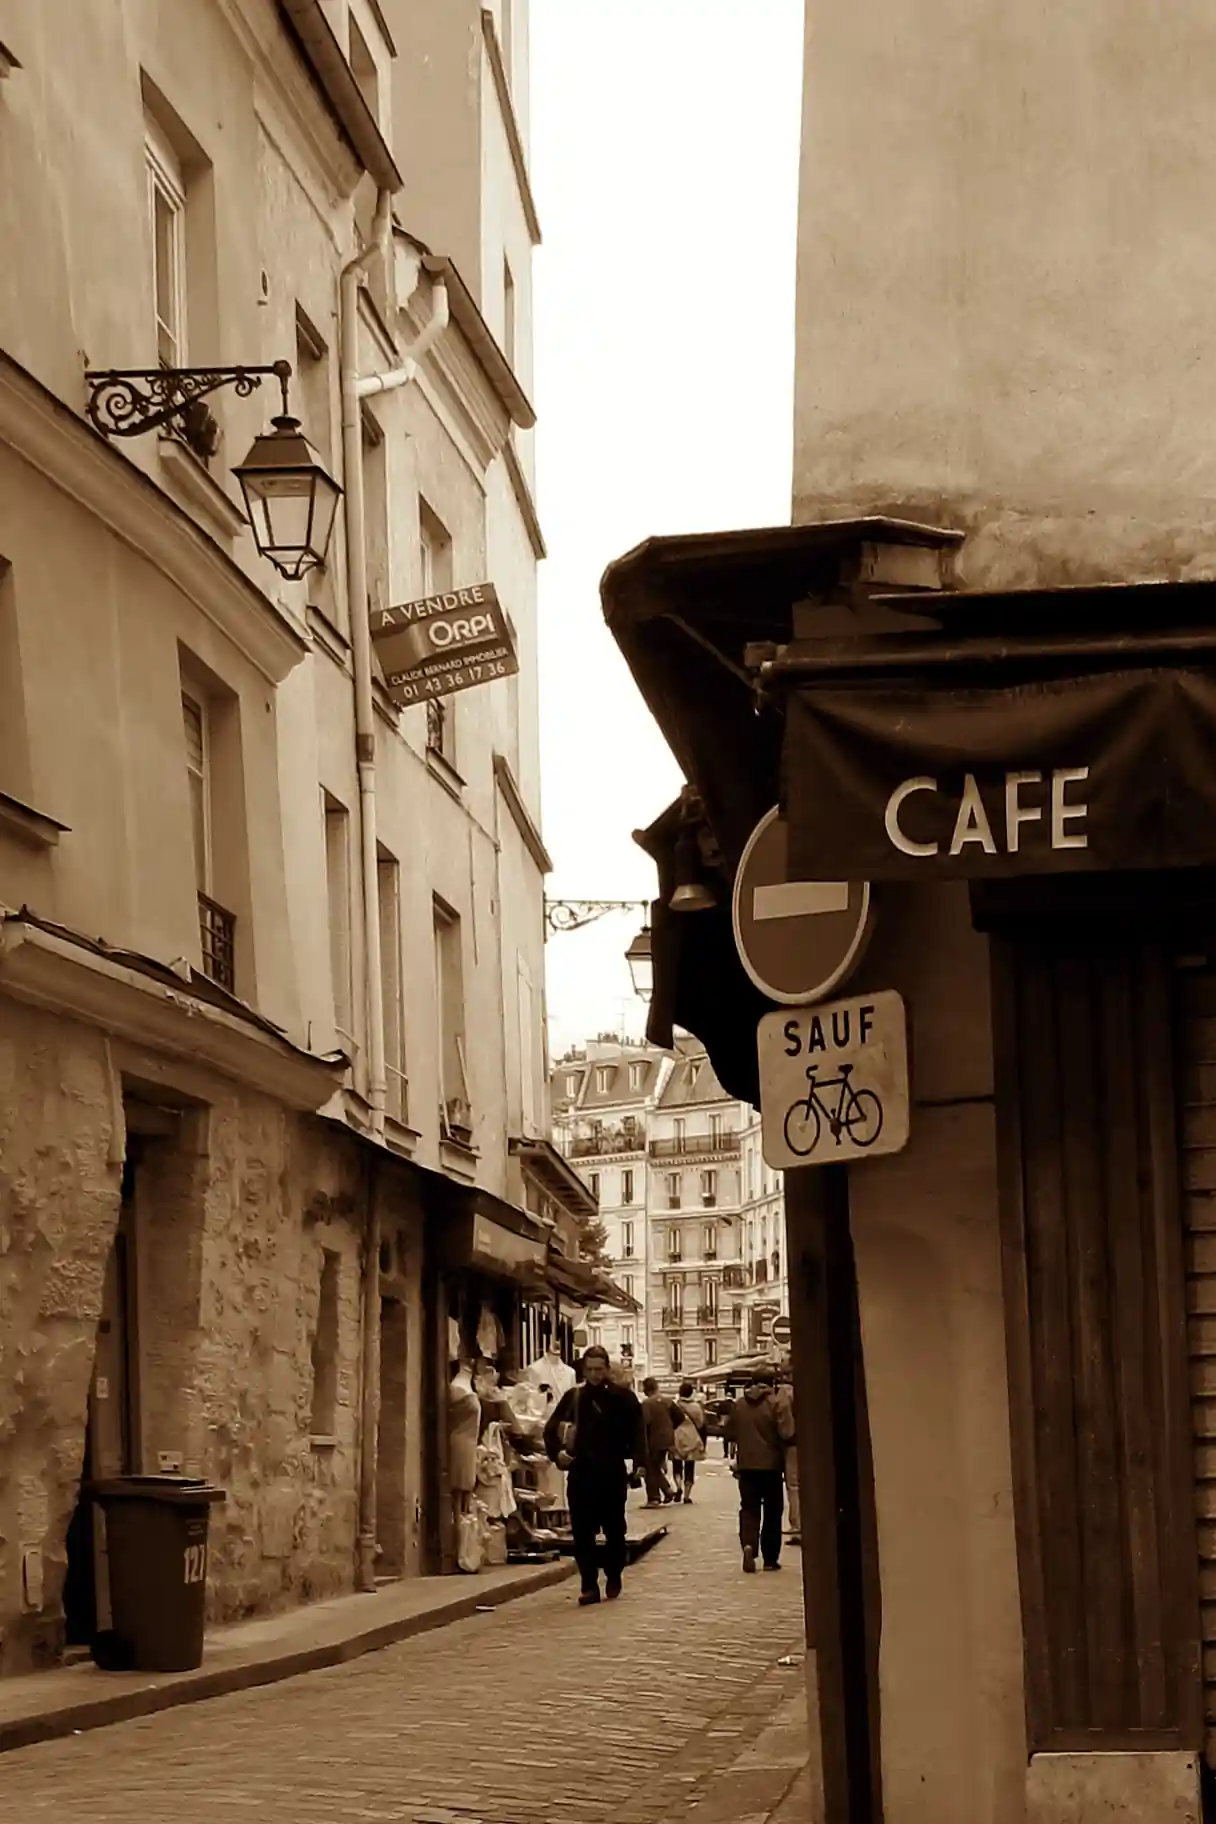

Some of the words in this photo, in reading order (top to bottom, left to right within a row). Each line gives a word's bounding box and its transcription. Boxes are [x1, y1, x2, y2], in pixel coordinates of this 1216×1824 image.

[381, 611, 396, 627] A
[400, 587, 485, 620] VENDRE
[428, 613, 496, 646] ORPI
[391, 668, 424, 686] CLAUDE
[424, 659, 463, 676] BERNARD
[463, 647, 509, 666] IMMOBILIER
[403, 684, 419, 699] 01
[425, 679, 442, 692] 43
[447, 673, 464, 687] 36
[468, 667, 483, 681] 17
[489, 662, 506, 676] 36
[884, 766, 1089, 857] CAFE
[784, 1005, 875, 1057] SAUF
